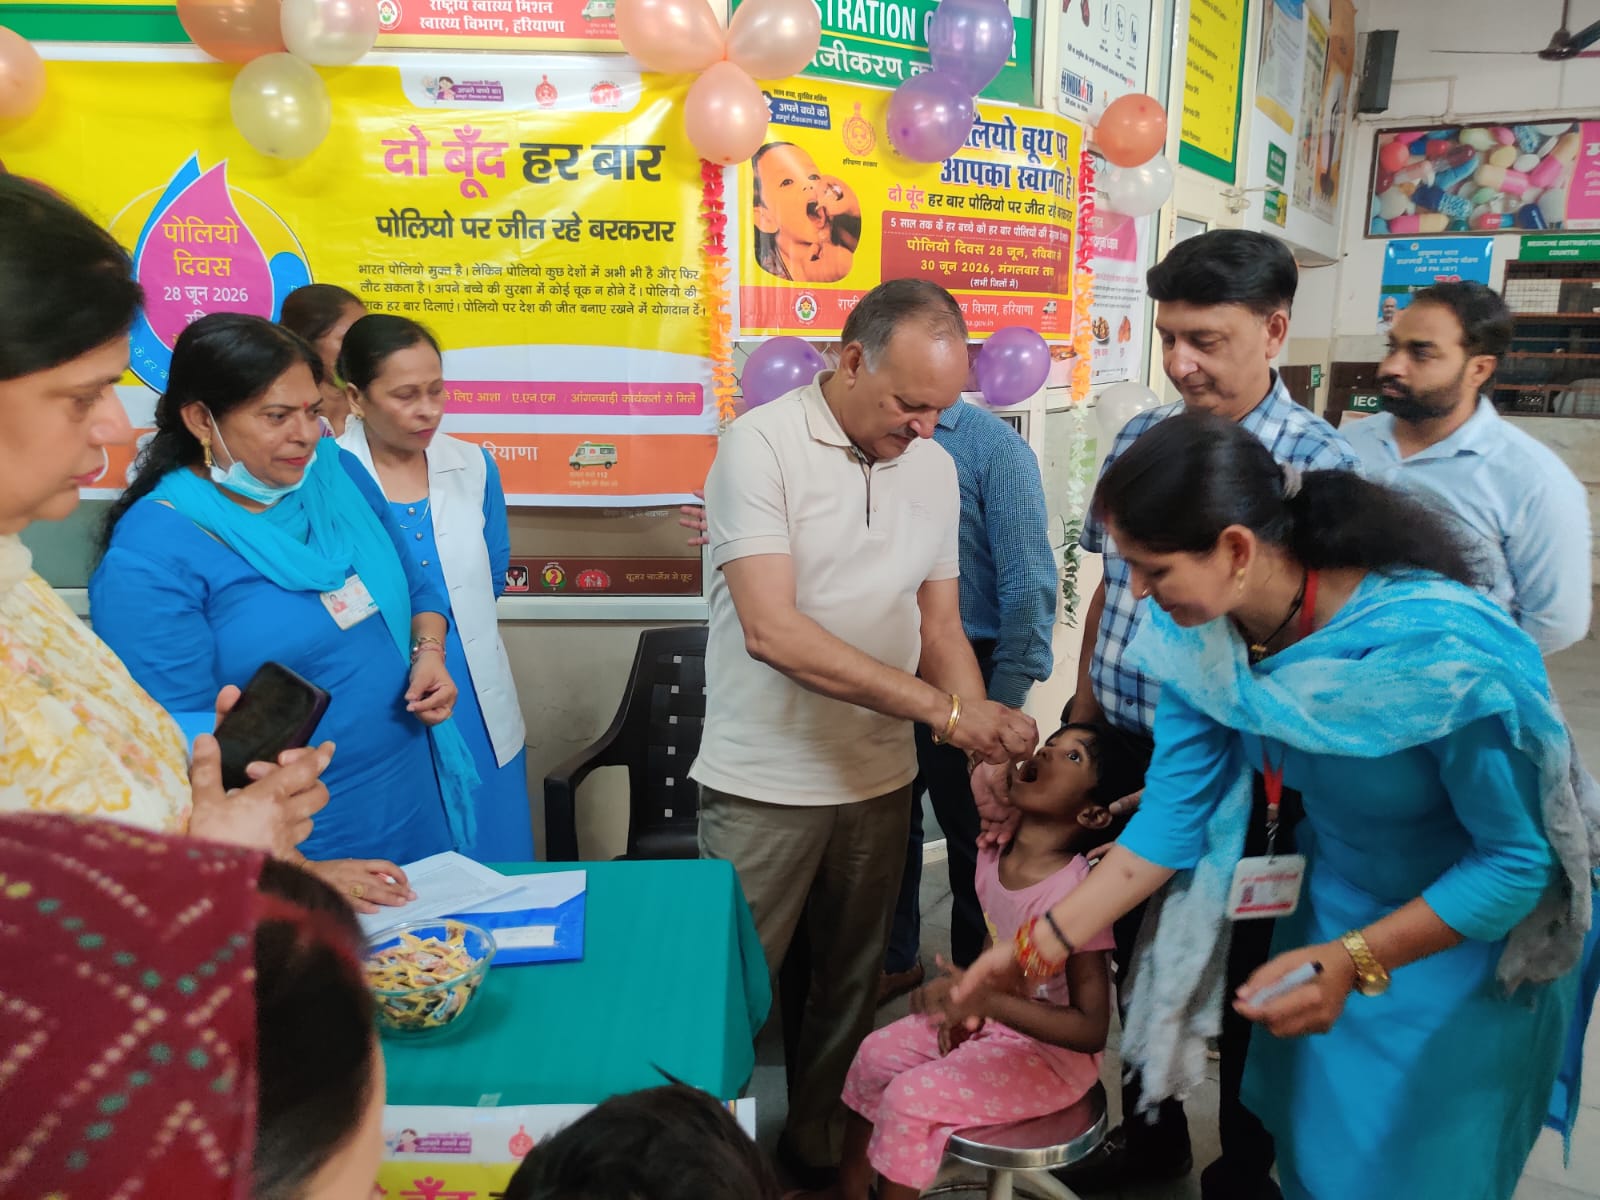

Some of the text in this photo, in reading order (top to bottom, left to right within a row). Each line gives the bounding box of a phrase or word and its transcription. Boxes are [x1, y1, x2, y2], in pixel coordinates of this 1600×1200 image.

[420, 17, 460, 30] स्वास्थ्य
[464, 15, 509, 33] विभाग,
[513, 17, 566, 34] हरियाणा
[811, 40, 904, 80] जीकरण
[778, 102, 828, 117] अपने बच्चे को
[963, 115, 1017, 152] लियो
[1022, 127, 1054, 164] बूथ
[381, 124, 666, 198] दो बूँद हर बार
[842, 158, 859, 166] हरियाणा
[940, 157, 1012, 188] आपका
[1017, 165, 1064, 196] स्वागत
[888, 184, 902, 202] दो
[928, 193, 943, 207] हर
[968, 193, 1004, 212] पोलियो
[1008, 201, 1021, 214] पर
[1024, 199, 1045, 215] जीत
[162, 215, 240, 244] पोलियो
[376, 207, 676, 242] पोलियो पर जीत रहे बरकरार
[890, 218, 897, 227] 5
[900, 218, 916, 229] साल
[919, 220, 933, 230] तक
[936, 219, 944, 231] के
[945, 222, 955, 232] हर
[958, 221, 974, 233] बच्चे
[976, 223, 986, 234] को
[988, 226, 998, 235] हर
[1014, 225, 1036, 237] पोलियो
[1038, 227, 1047, 238] की
[906, 236, 949, 253] पोलियो
[954, 240, 984, 256] दिवस
[988, 246, 1002, 256] 28
[1006, 247, 1027, 261] जून,
[173, 249, 232, 277] दिवस
[359, 264, 384, 275] भारत
[389, 262, 424, 276] पोलियो
[428, 266, 451, 279] मुक्त
[472, 263, 502, 277] लेकिन
[507, 263, 541, 277] पोलियो
[546, 267, 564, 280] कुछ
[568, 264, 586, 278] देशों
[591, 264, 600, 278] में
[604, 266, 626, 279] अभी
[630, 266, 642, 279] भी
[646, 265, 653, 279] है
[657, 265, 676, 280] और
[680, 267, 699, 280] फिर
[920, 260, 934, 270] 30
[939, 261, 957, 276] जून
[961, 262, 994, 275] 2026,
[998, 262, 1040, 276] मंगलवार
[360, 280, 381, 293] लौट
[384, 282, 413, 293] सकता
[434, 282, 460, 294] अपने
[464, 282, 483, 294] बच्चे
[487, 281, 500, 294] की
[505, 284, 532, 299] सुरक्षा
[536, 281, 545, 295] में
[549, 280, 570, 297] कोई
[574, 285, 591, 299] चूक
[595, 286, 602, 295] न
[607, 282, 625, 297] होने
[645, 283, 680, 297] पोलियो
[684, 284, 697, 298] की
[970, 278, 988, 288] (सभी
[990, 277, 1008, 288] जिलों
[163, 286, 249, 305] 28 जून 2026
[387, 301, 400, 312] हर
[403, 302, 420, 312] बार
[463, 299, 499, 313] पोलियो
[502, 303, 516, 313] पर
[519, 300, 535, 313] देश
[539, 301, 552, 313] की
[556, 301, 576, 313] जीत
[580, 303, 606, 315] बनाए
[610, 301, 634, 315] रखने
[638, 301, 648, 315] में
[651, 302, 690, 315] योगदान
[972, 299, 999, 316] विभाग,
[1002, 300, 1034, 316] हरियाणा
[453, 390, 473, 403] लिए
[477, 392, 501, 402] आशा
[622, 392, 660, 404] कार्यकर्ता
[664, 392, 673, 404] से
[676, 391, 697, 404] मिलें
[1353, 395, 1378, 407] IEC
[482, 440, 539, 461] रियाणा
